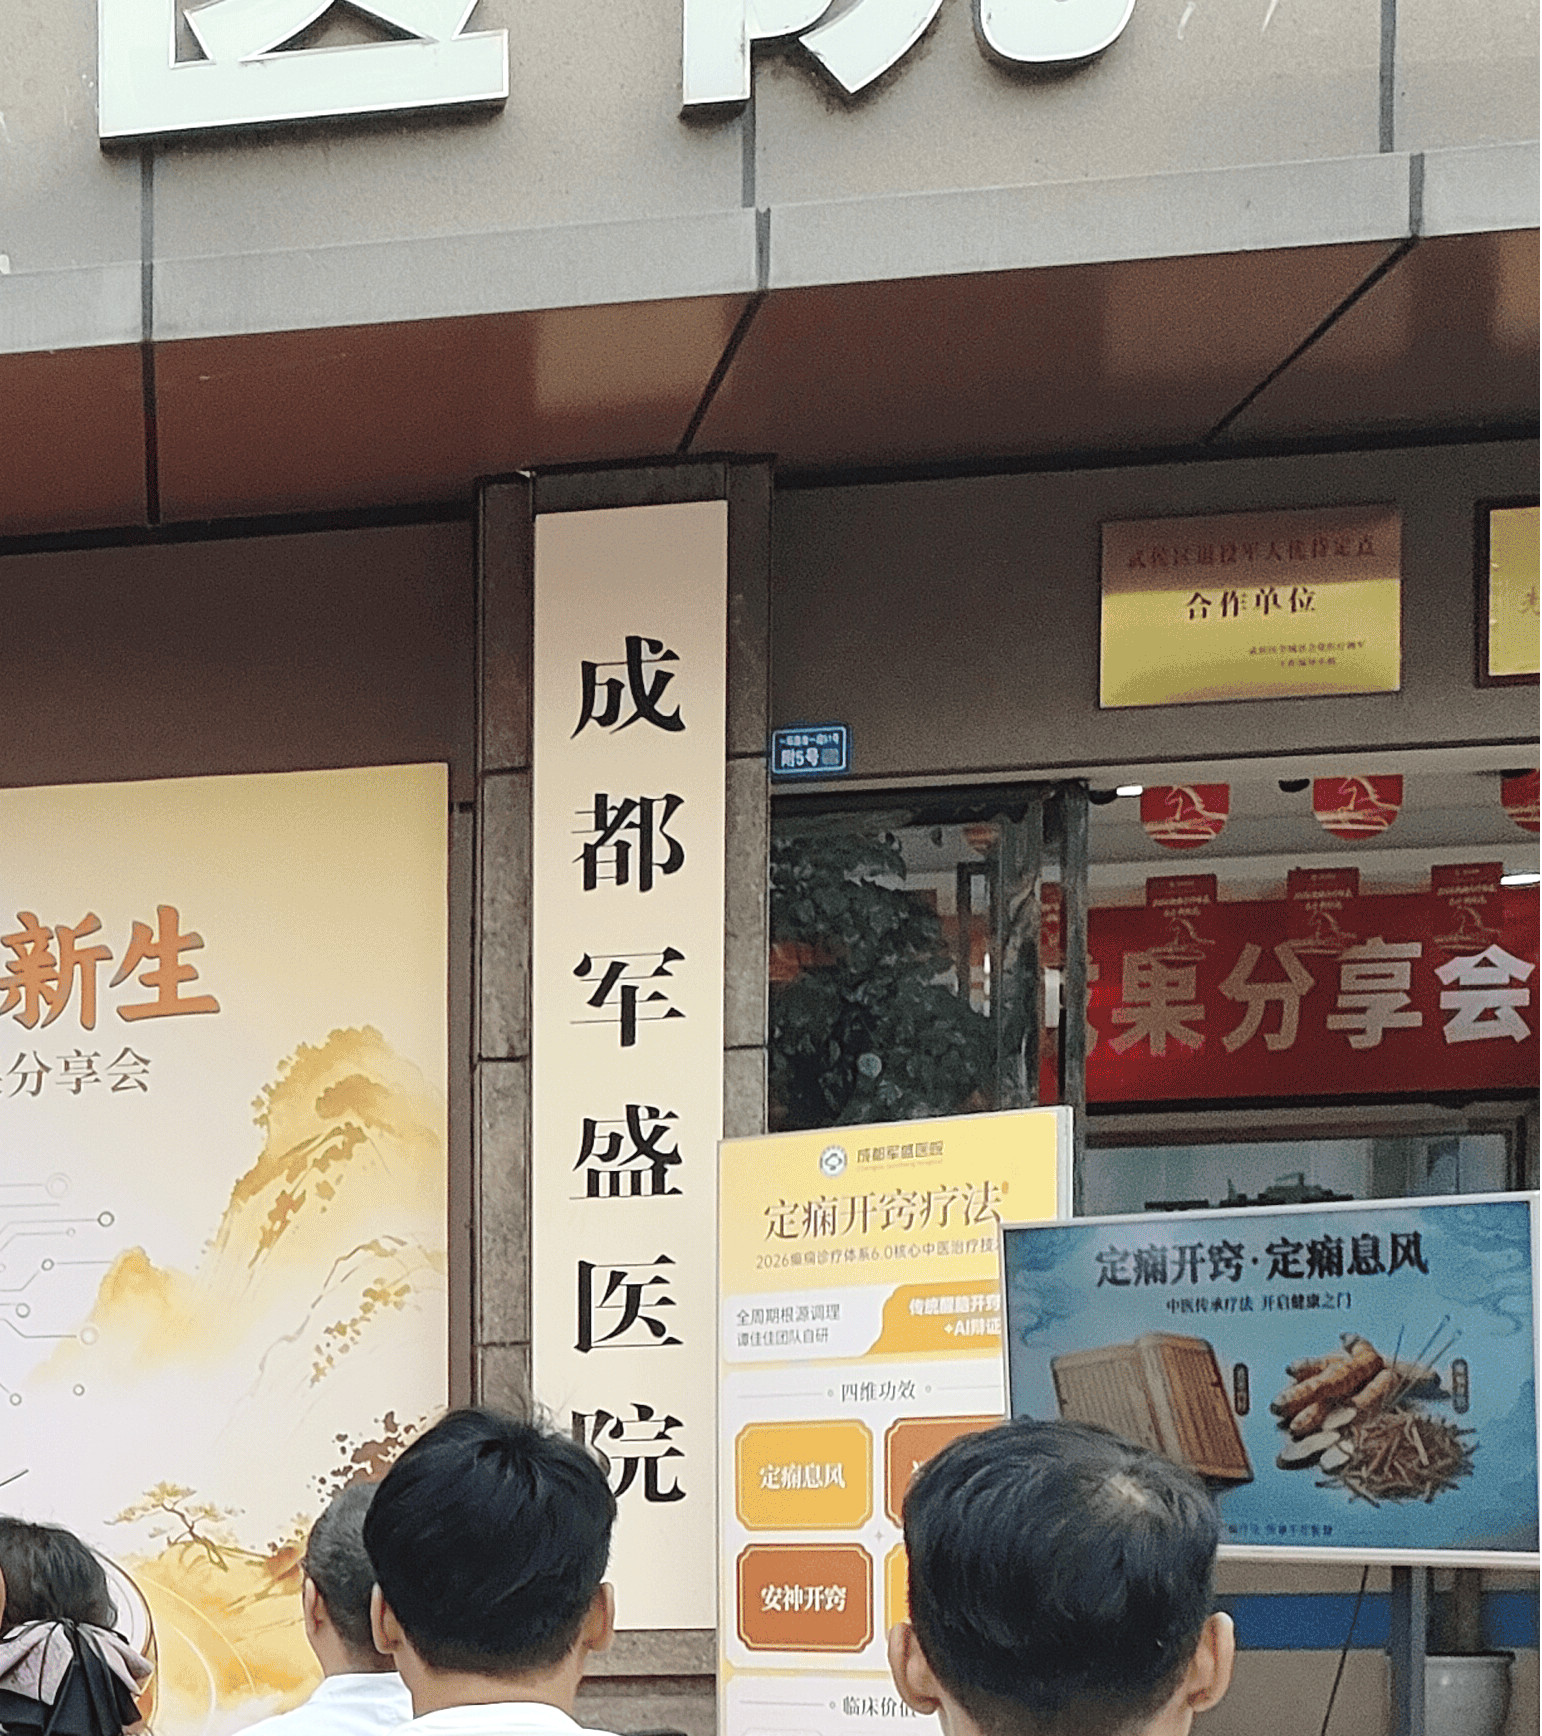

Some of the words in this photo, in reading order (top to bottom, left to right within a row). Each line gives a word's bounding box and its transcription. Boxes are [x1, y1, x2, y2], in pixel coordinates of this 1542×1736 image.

[1187, 586, 1316, 620] 合作单位
[1085, 936, 1536, 1059] 果分享会
[570, 634, 686, 1503] 成都军盛医院
[764, 1180, 1002, 1242] 定痫开窍疗法
[1094, 1230, 1430, 1288] 定痫开窍·定痫息风
[735, 1303, 841, 1327] 全周期根源调理
[840, 1379, 916, 1402] 四维功效
[758, 1461, 846, 1491] 定痫息风
[760, 1583, 848, 1614] 安神开窍
